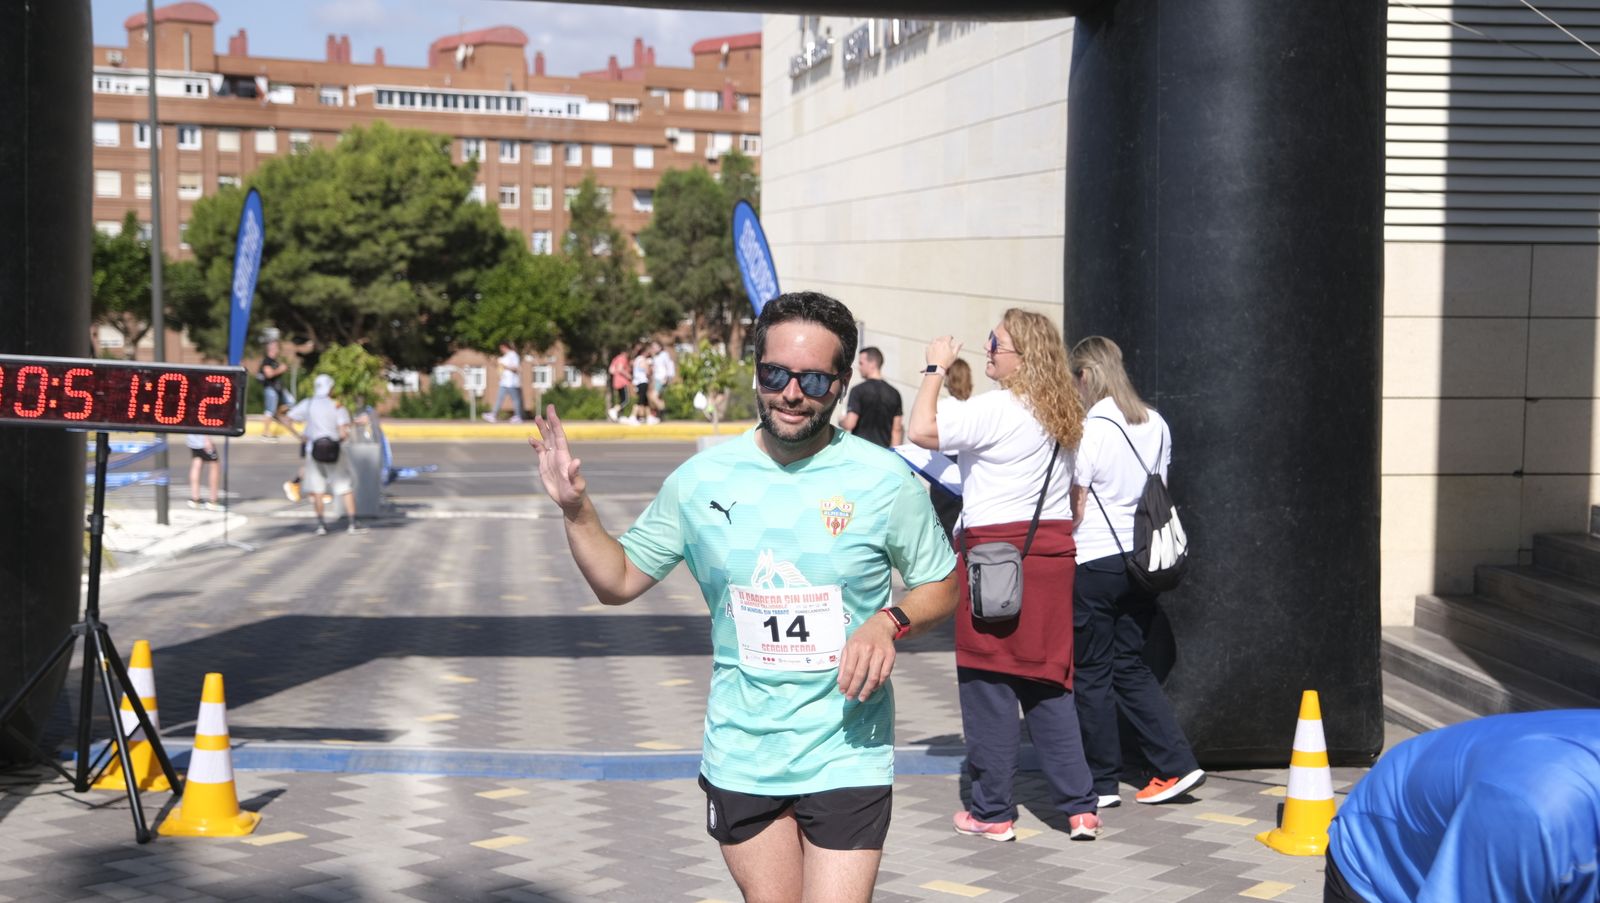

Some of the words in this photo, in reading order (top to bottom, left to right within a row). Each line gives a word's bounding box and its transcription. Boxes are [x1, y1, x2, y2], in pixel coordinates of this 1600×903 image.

[0, 365, 232, 427] 0:51:02
[745, 592, 781, 604] CARRERA
[784, 593, 801, 604] SIN
[802, 592, 829, 603] HUMO
[763, 614, 810, 643] 14
[761, 643, 789, 653] SERGIO
